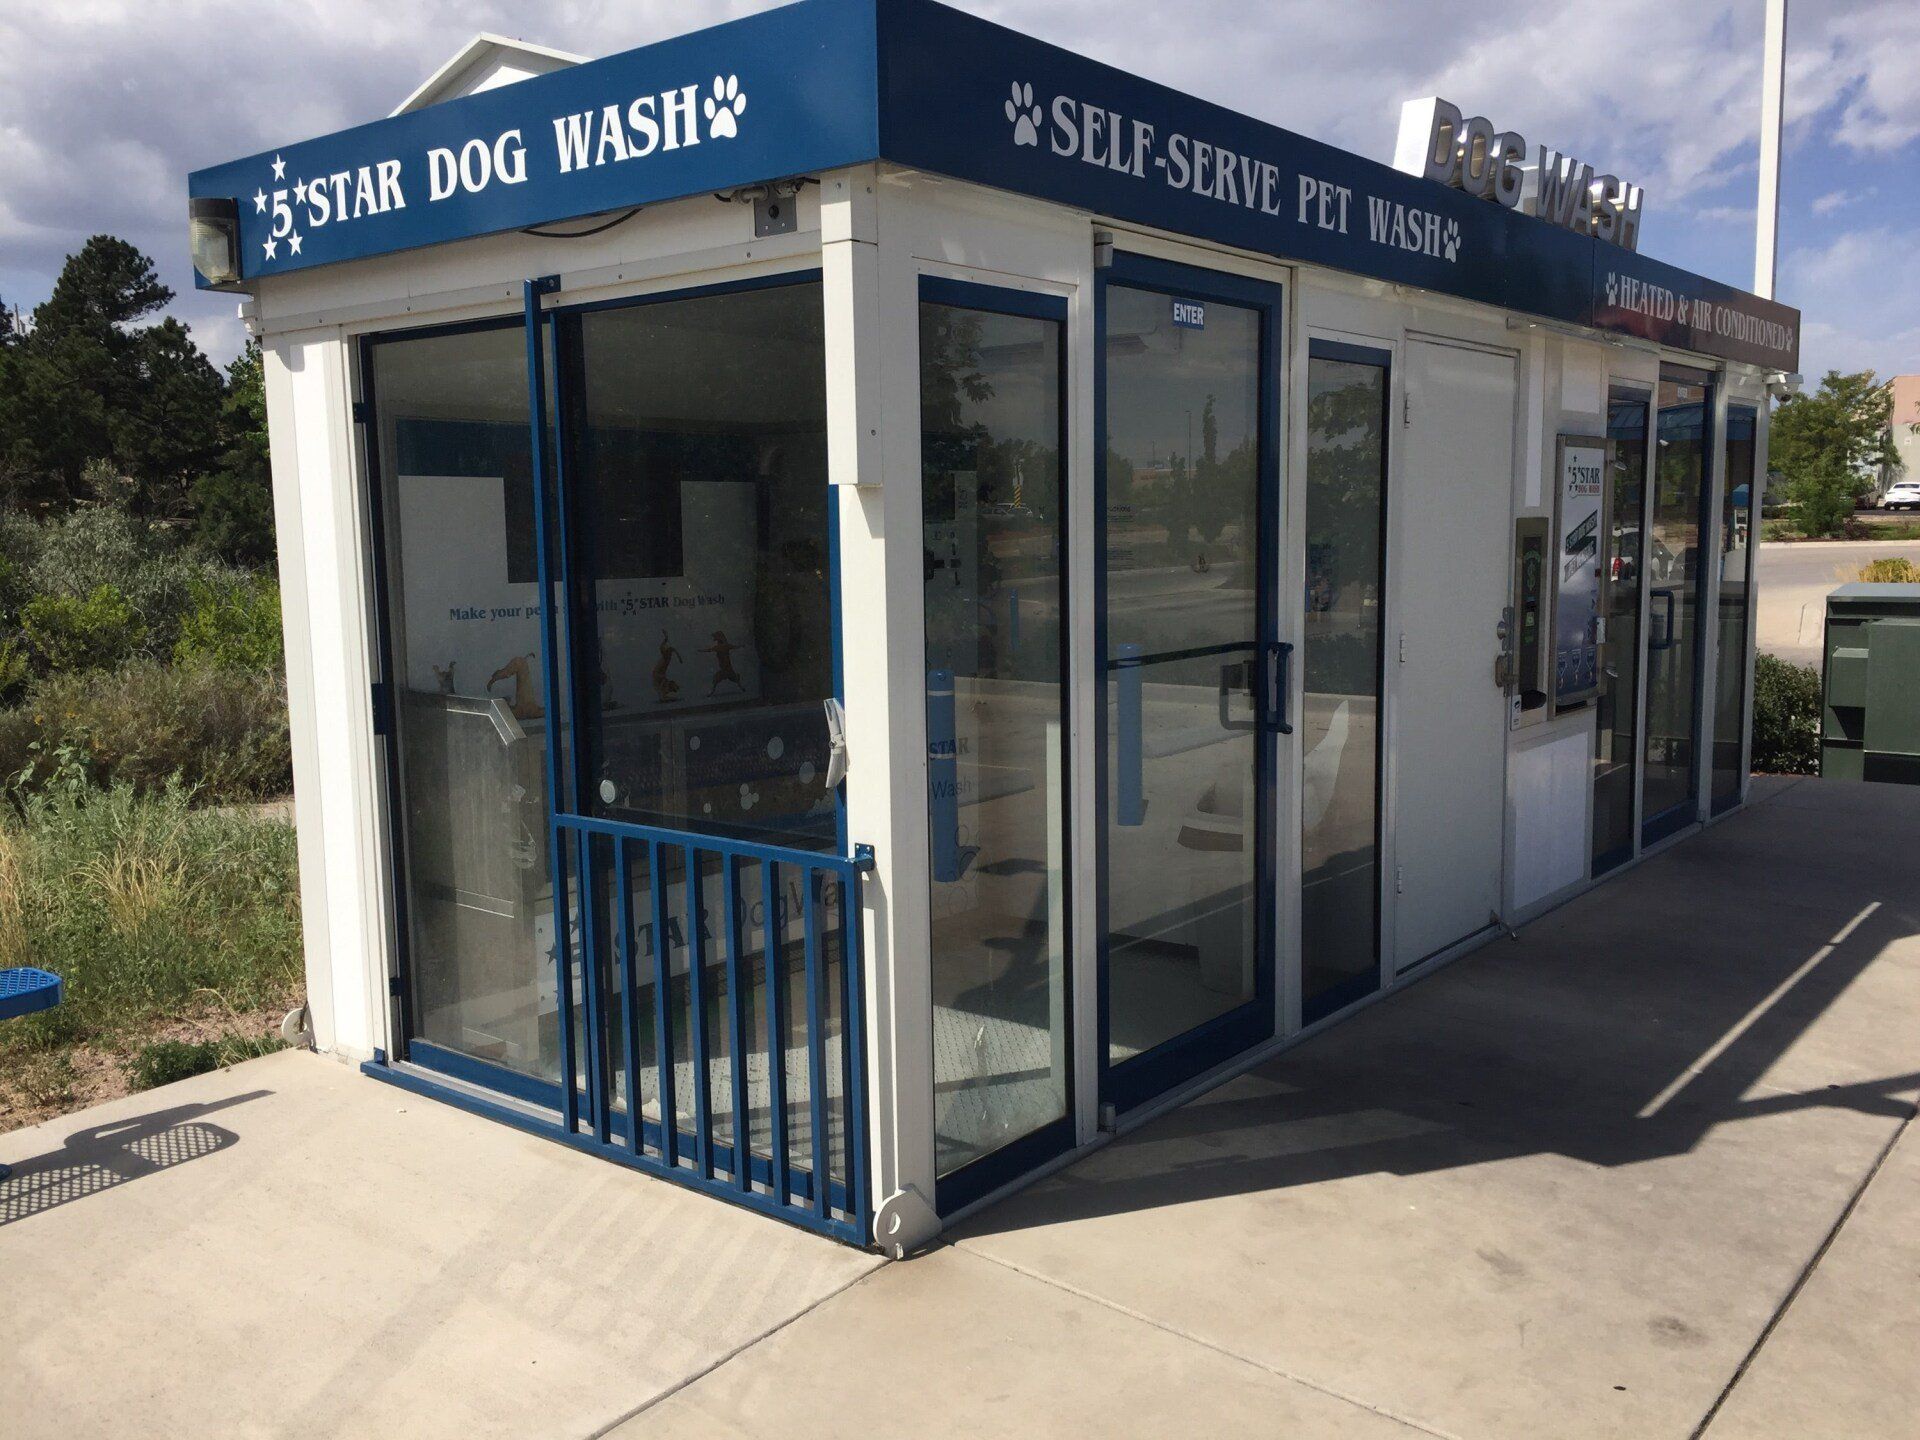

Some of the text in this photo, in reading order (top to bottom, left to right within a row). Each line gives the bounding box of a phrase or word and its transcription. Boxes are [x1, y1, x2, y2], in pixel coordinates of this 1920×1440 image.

[271, 83, 701, 239] 5 STAR DOG WASH
[1424, 96, 1645, 253] DOG WASH
[1050, 95, 1443, 259] SELF-SERVE PET WASH
[1173, 302, 1204, 326] ENTER
[1619, 274, 1786, 351] HEATED & AIR CONDITIONED
[1580, 467, 1601, 485] STAR
[449, 606, 487, 621] Make
[490, 607, 522, 622] your
[625, 598, 634, 612] 5
[639, 596, 669, 609] STAR
[673, 594, 696, 609] Dog
[929, 737, 970, 755] STAR
[931, 776, 972, 800] Wash
